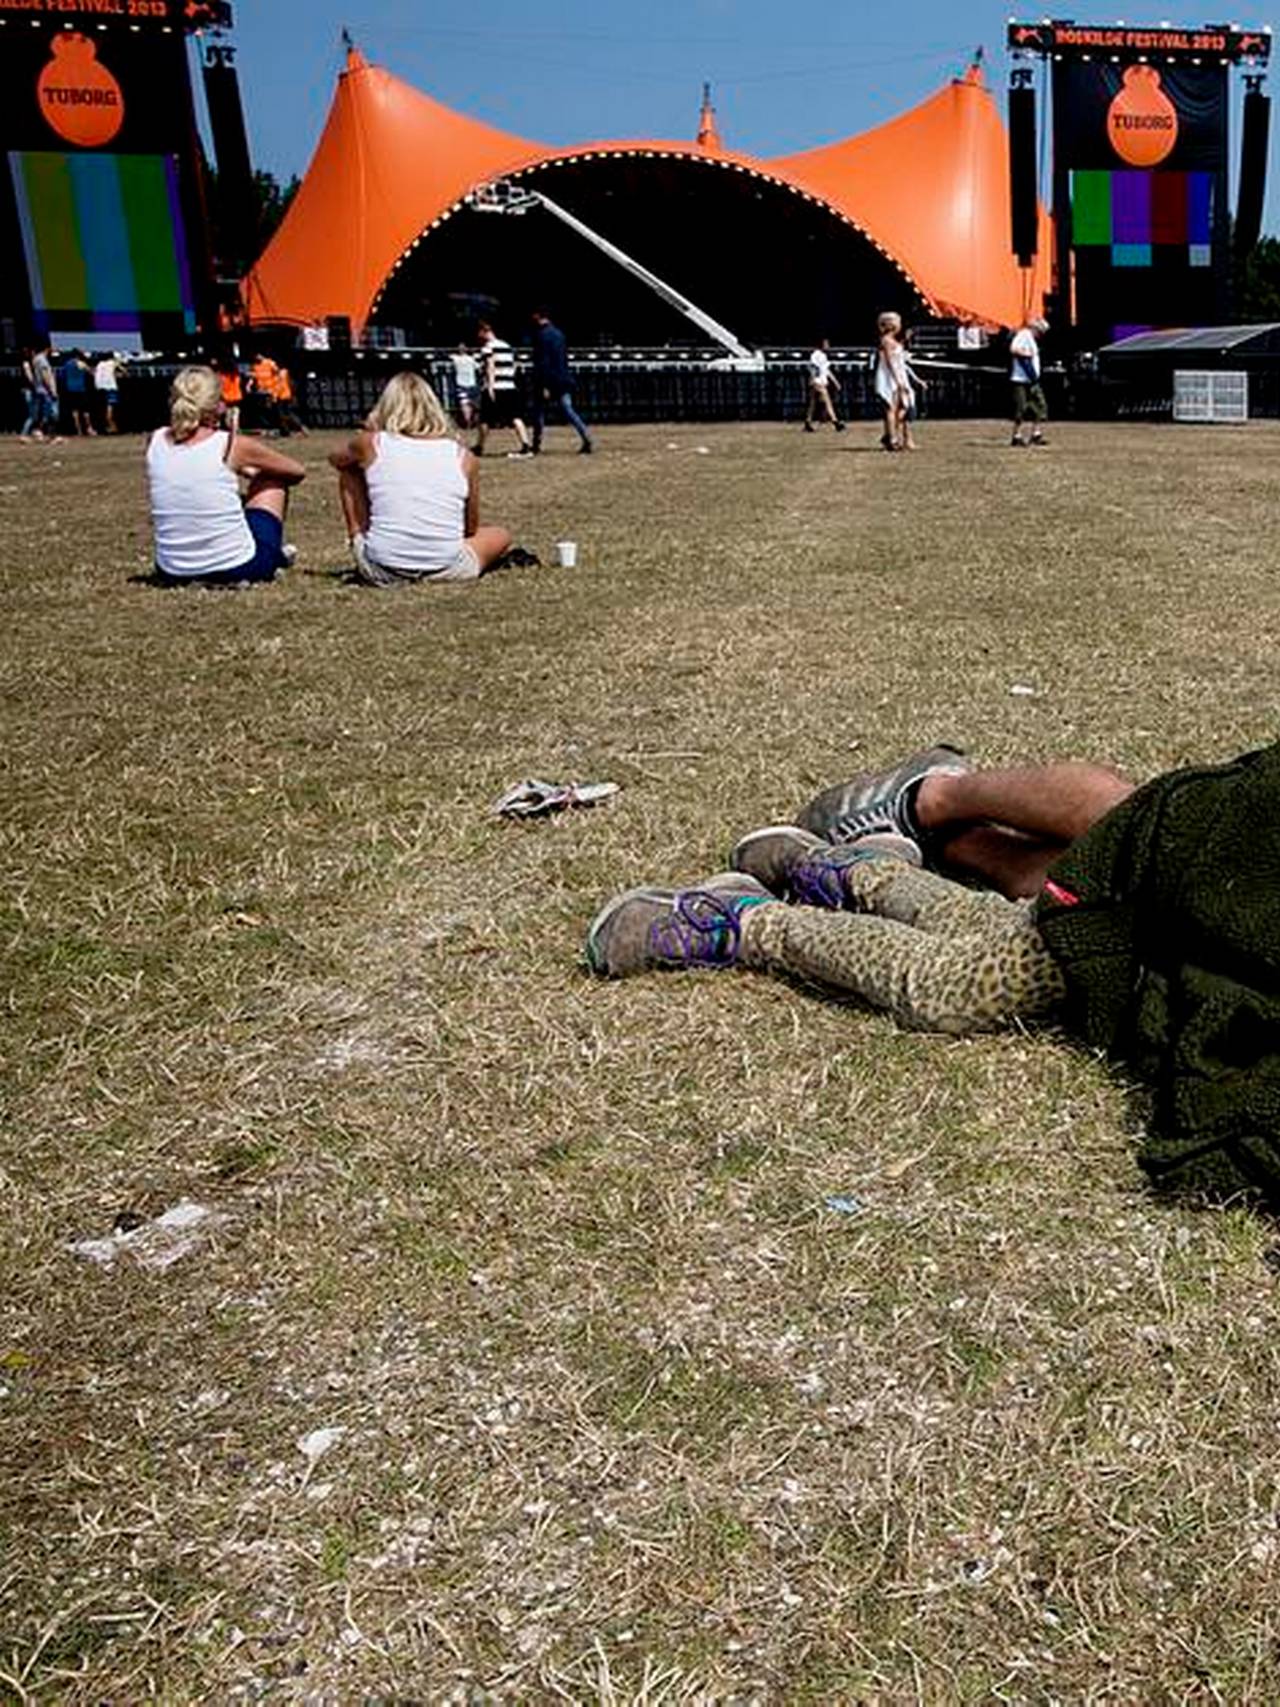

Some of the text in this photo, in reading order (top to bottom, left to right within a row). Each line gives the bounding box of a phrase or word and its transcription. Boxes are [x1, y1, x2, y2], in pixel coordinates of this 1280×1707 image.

[1055, 29, 1124, 46] ROSKILDE
[1126, 31, 1190, 49] FESTIVAL
[42, 87, 119, 107] TUBORG
[1112, 113, 1173, 130] TUBORG
